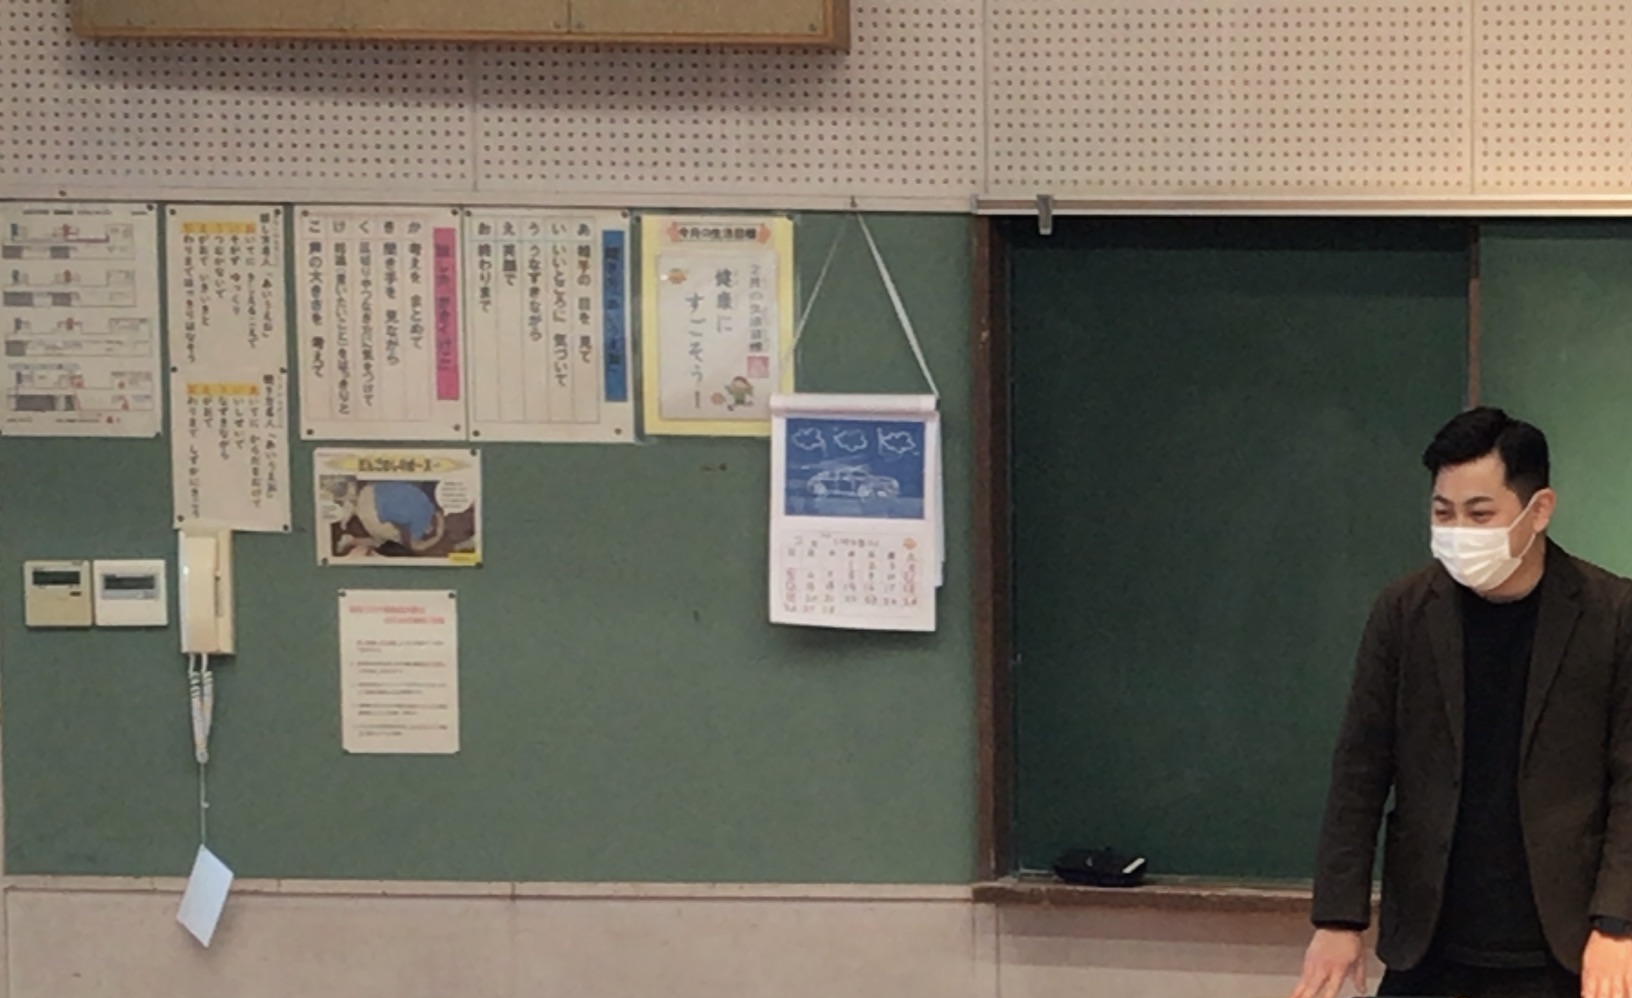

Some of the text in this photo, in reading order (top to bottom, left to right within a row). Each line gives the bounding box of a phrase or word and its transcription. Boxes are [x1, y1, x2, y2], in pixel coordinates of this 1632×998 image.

[679, 228, 757, 240] 今月の生活目標
[715, 268, 733, 334] 健康に
